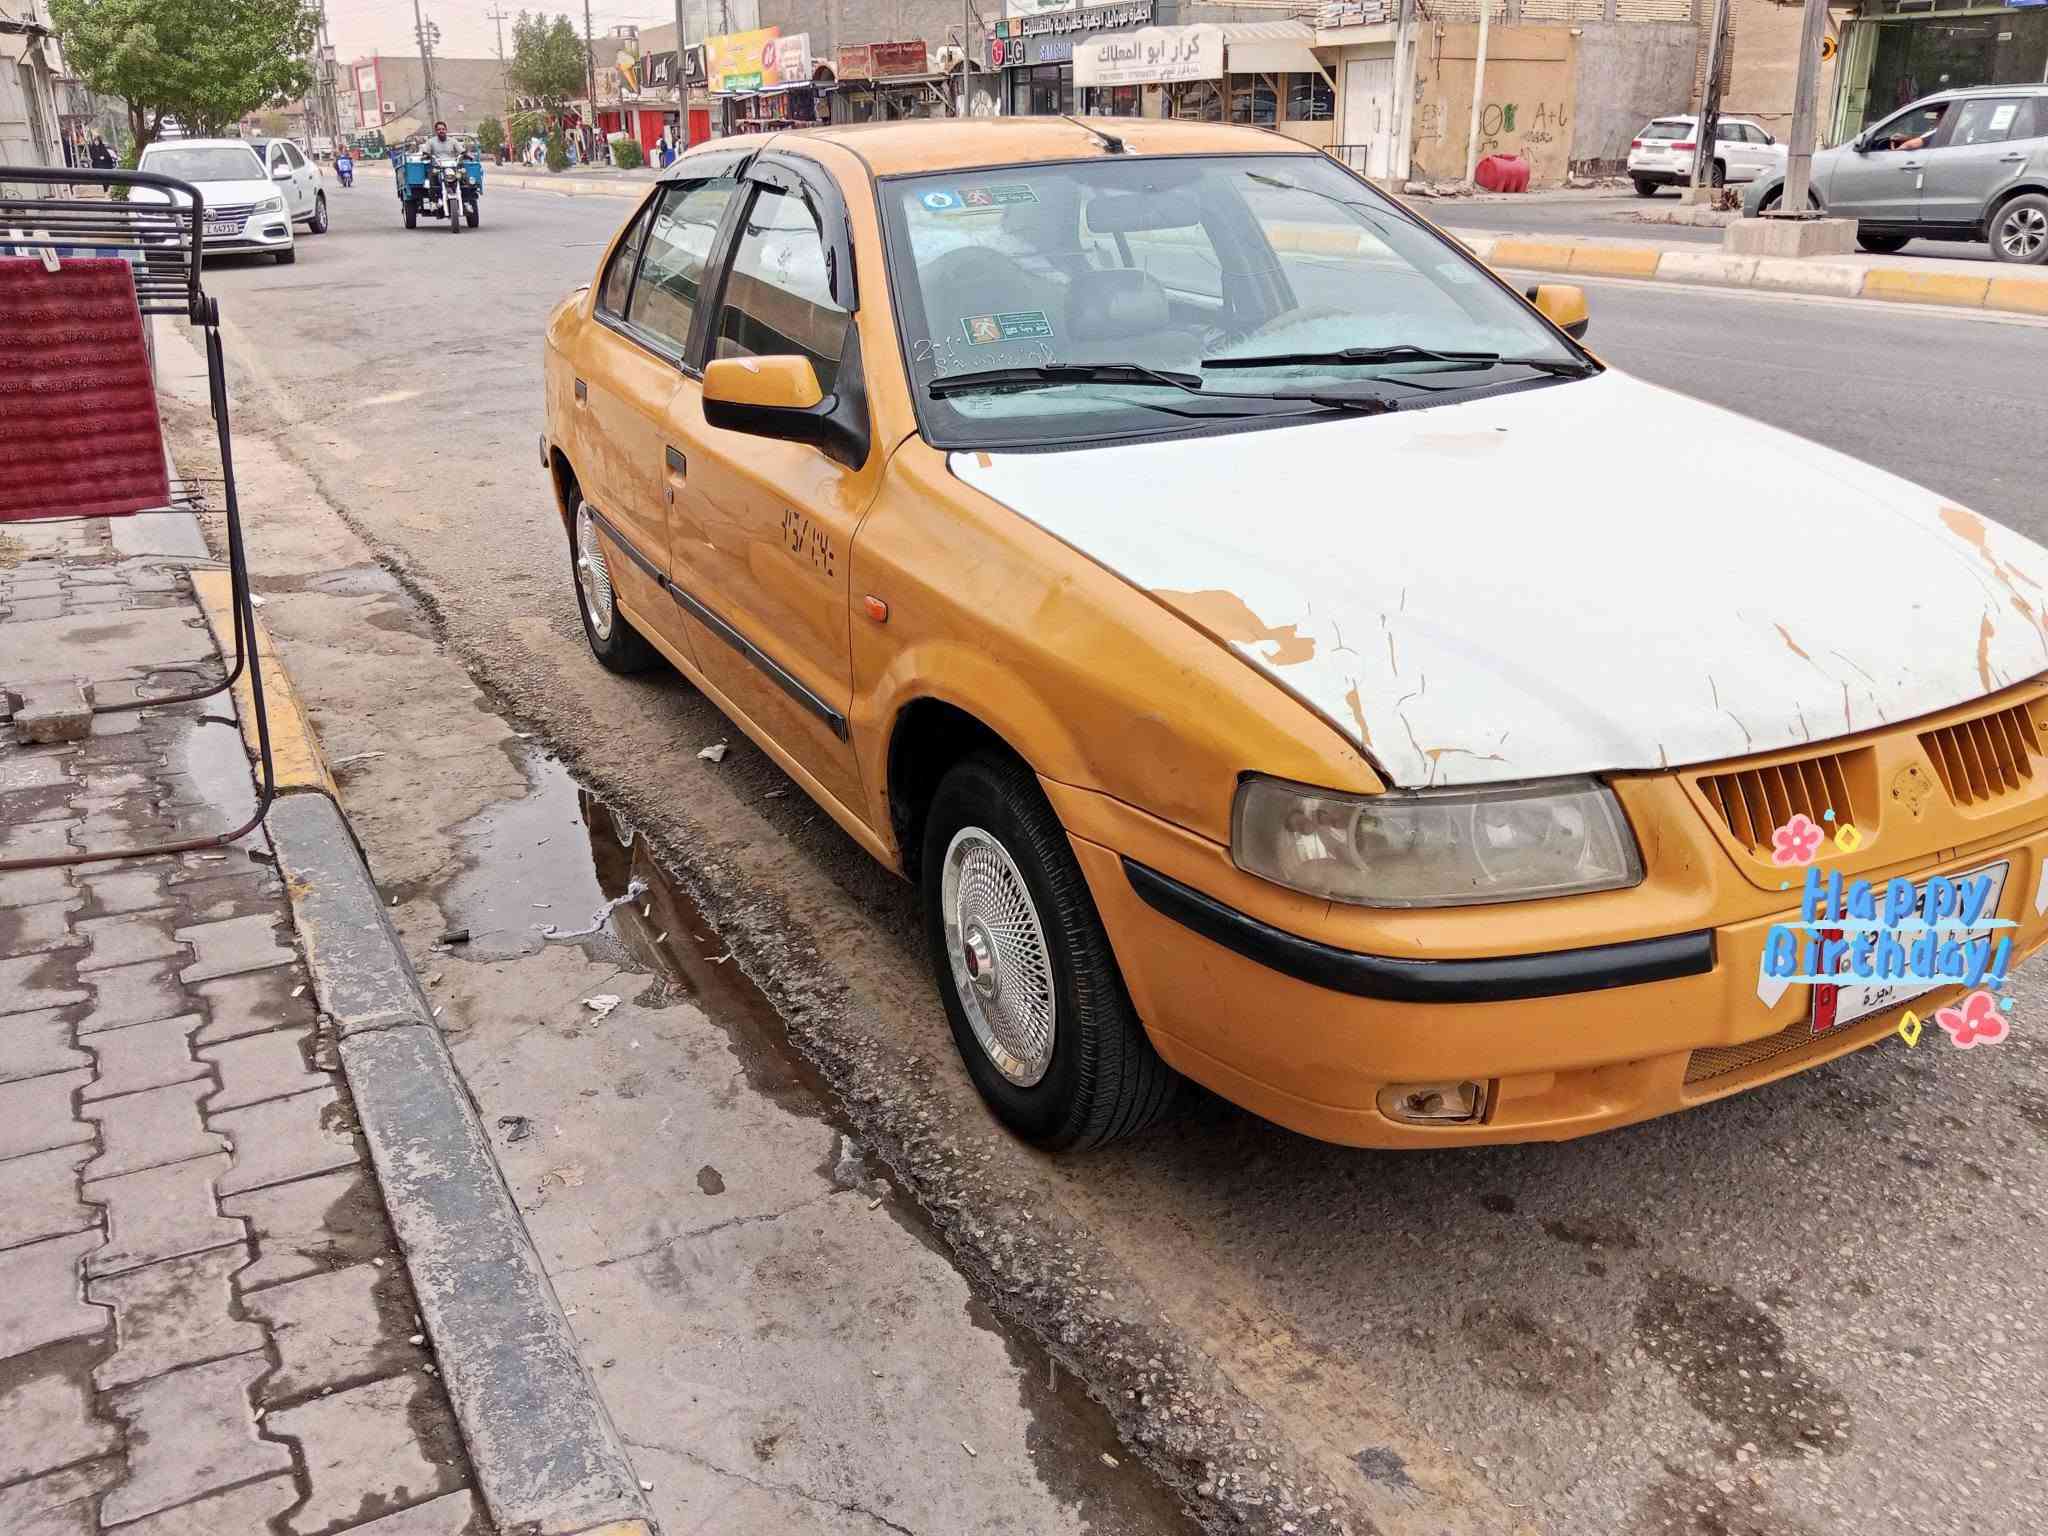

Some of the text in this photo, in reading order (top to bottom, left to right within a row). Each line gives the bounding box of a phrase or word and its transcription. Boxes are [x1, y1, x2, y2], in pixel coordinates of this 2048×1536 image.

[1083, 11, 1104, 30] اجهزة
[1105, 6, 1128, 28] موبايل
[1129, 5, 1152, 25] اجهزة
[1004, 39, 1024, 64] LG
[1147, 40, 1164, 64] ابو
[1171, 33, 1200, 63] كرار
